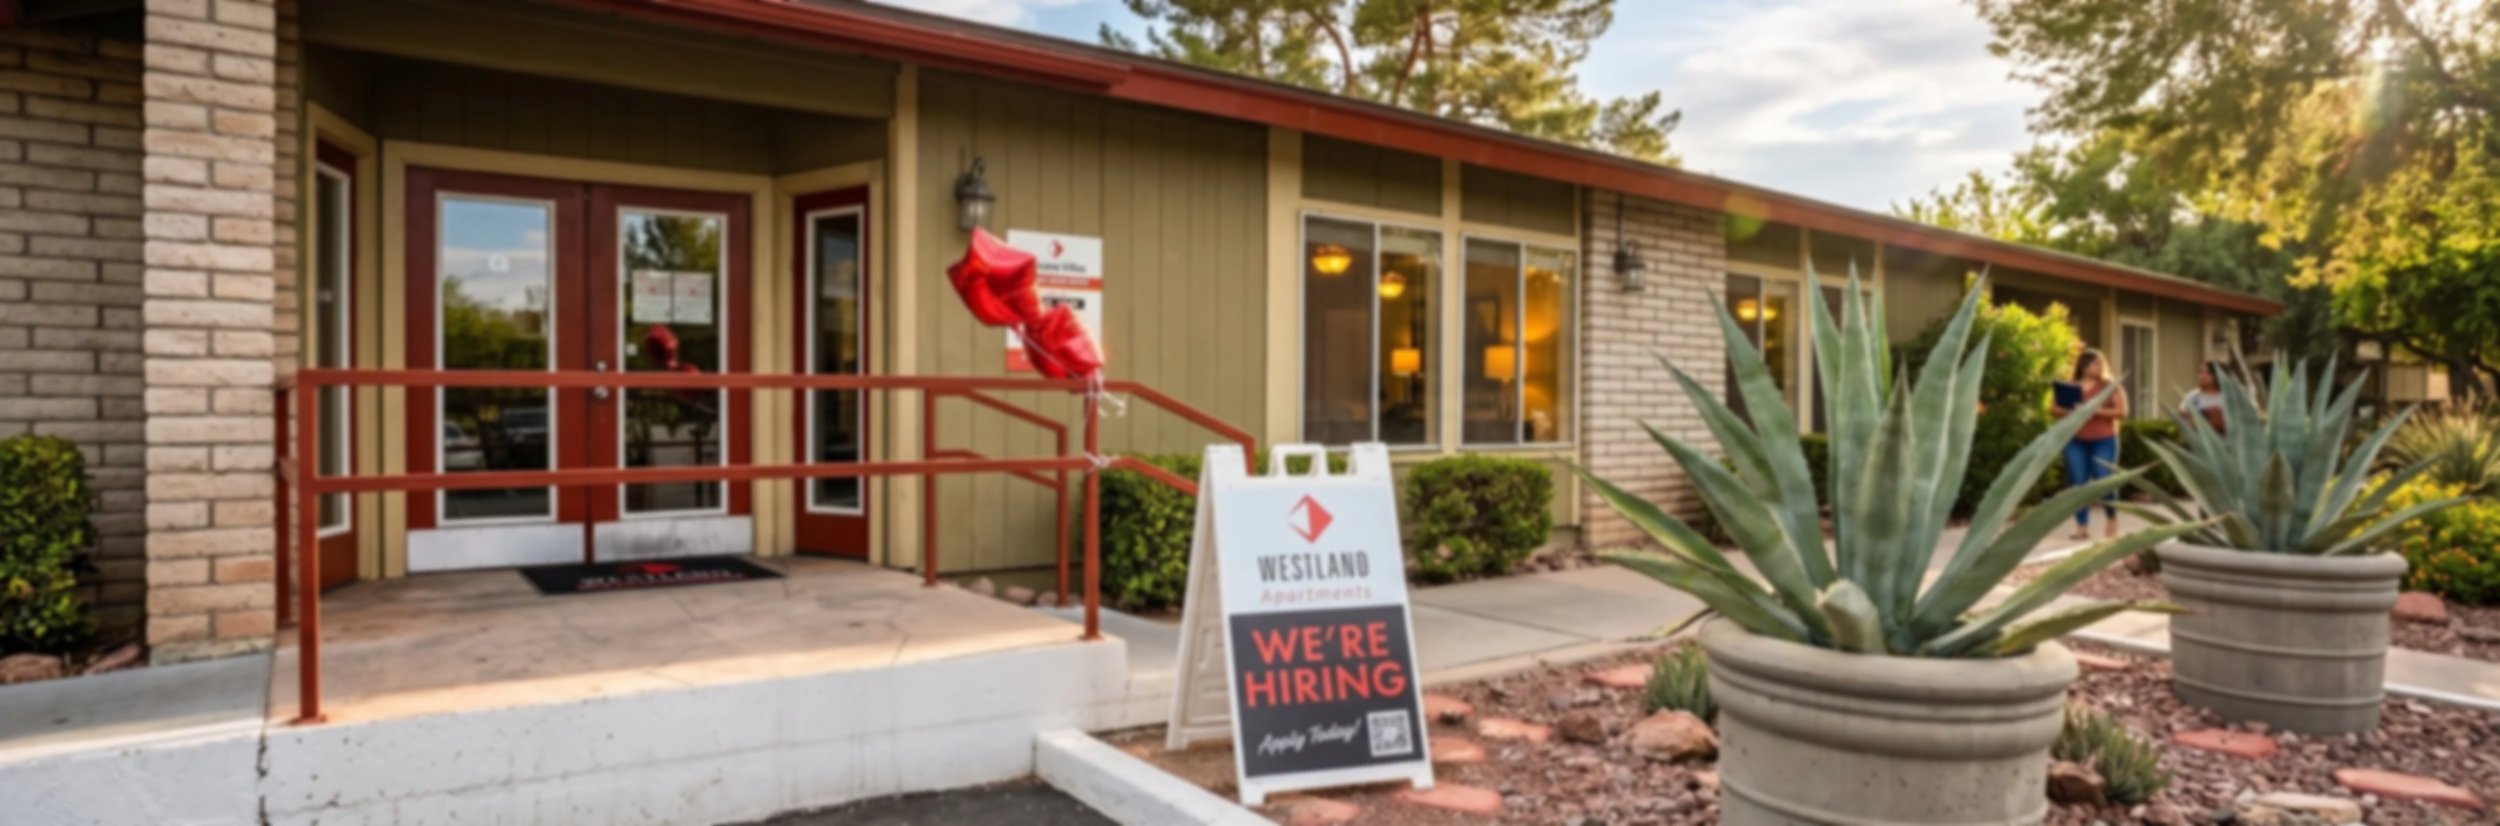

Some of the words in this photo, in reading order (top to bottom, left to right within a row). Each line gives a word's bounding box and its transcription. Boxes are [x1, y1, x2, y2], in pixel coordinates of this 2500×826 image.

[1257, 550, 1370, 582] WESTLAND
[1260, 585, 1373, 606] Apartments
[1251, 620, 1389, 664] WE'RE
[1244, 660, 1407, 709] HIRING
[1256, 729, 1306, 757] Apply
[1307, 717, 1362, 745] Today!
